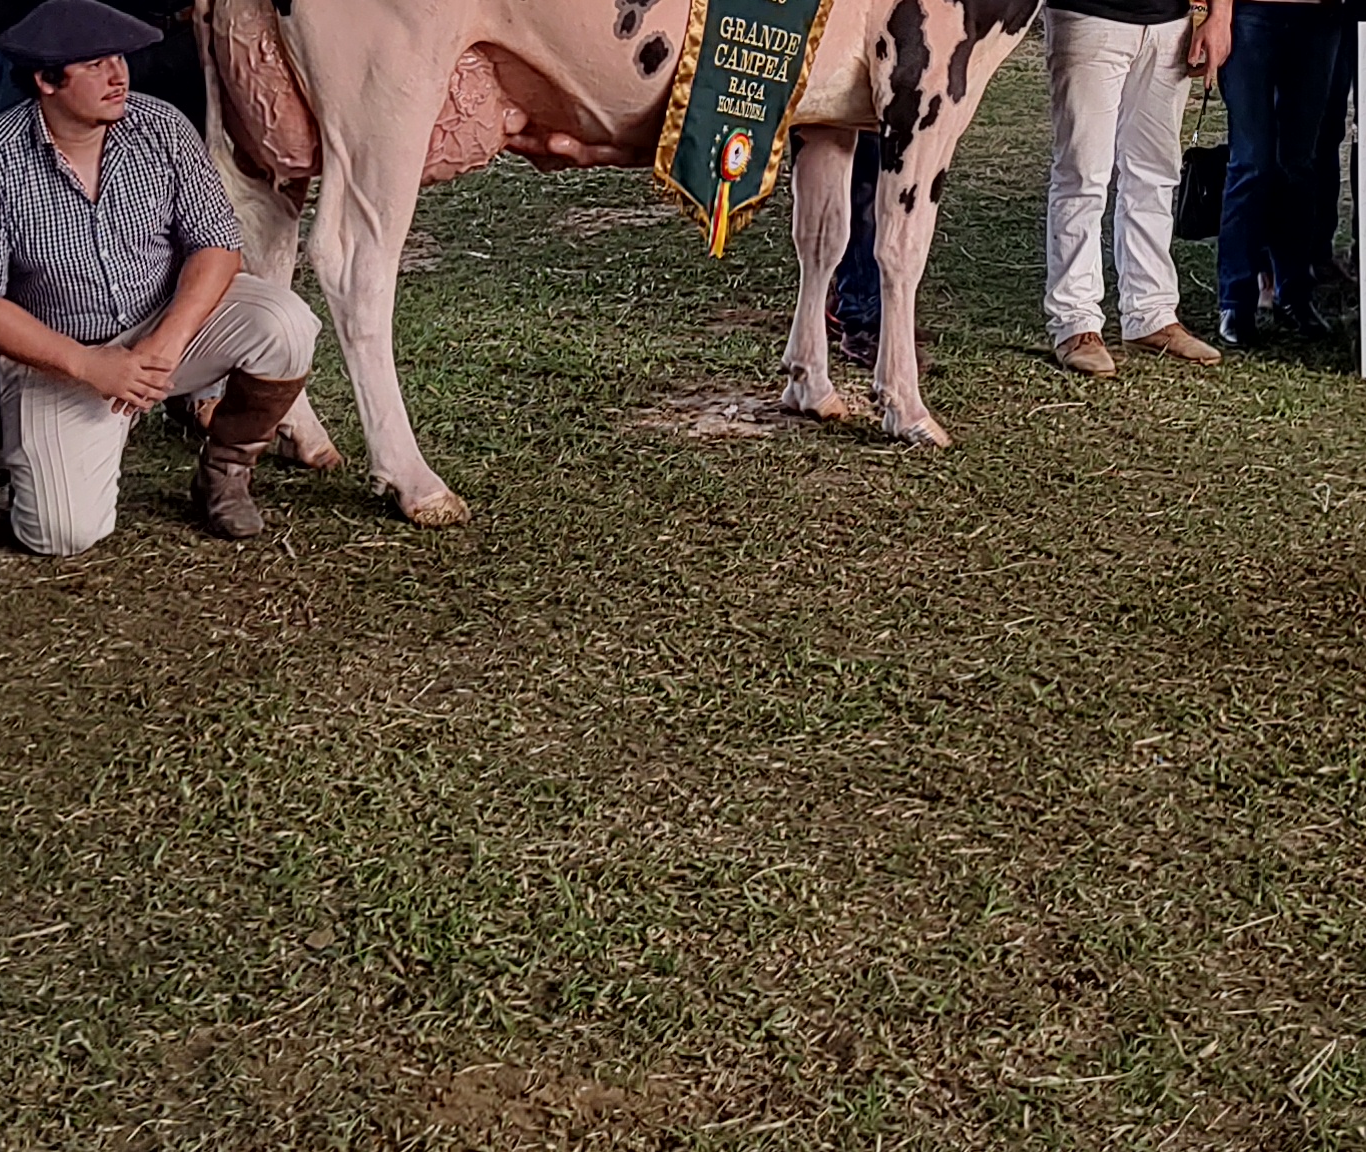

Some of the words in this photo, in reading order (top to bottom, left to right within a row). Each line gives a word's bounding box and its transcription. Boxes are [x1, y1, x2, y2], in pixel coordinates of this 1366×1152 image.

[720, 16, 802, 57] GRANDE
[714, 43, 793, 83] CAMPEÃ
[728, 76, 765, 102] RAÇA
[717, 95, 767, 122] HOLANDESA
